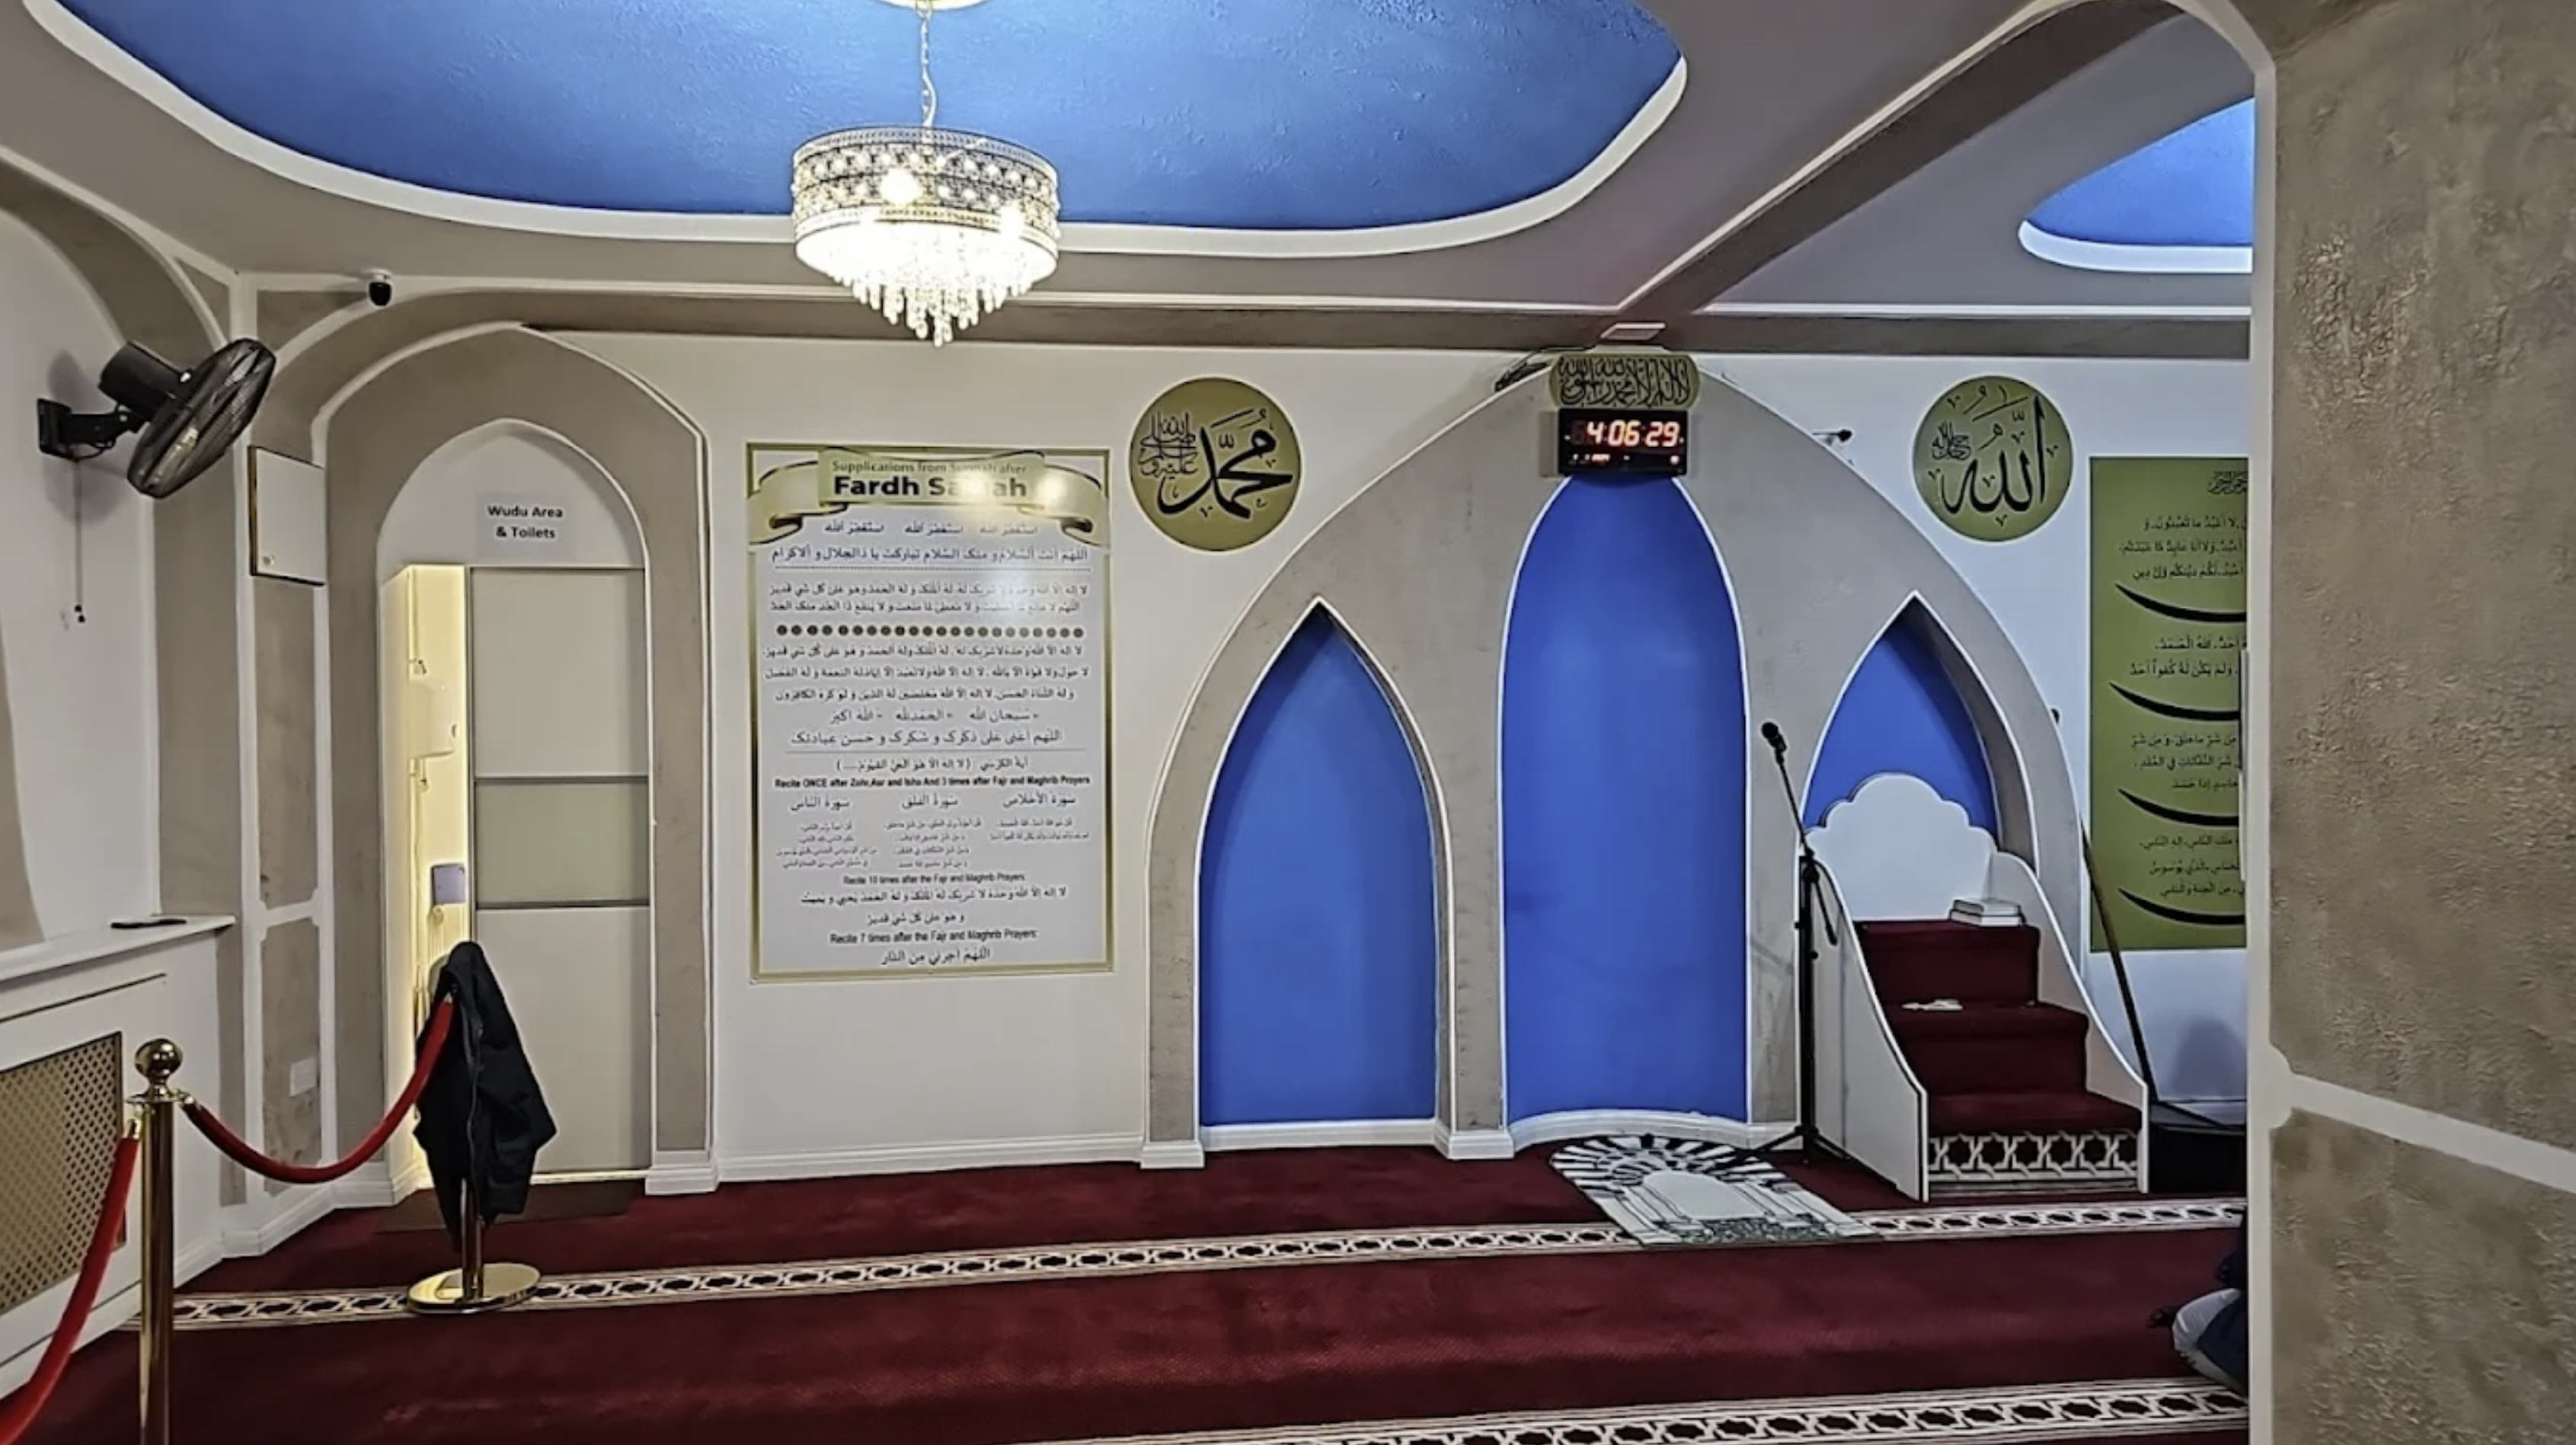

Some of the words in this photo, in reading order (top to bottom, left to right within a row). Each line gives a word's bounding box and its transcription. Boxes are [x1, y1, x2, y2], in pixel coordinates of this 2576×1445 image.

[1941, 395, 2046, 515] الله
[833, 460, 914, 474] Supplications
[917, 461, 947, 472] from
[999, 463, 1027, 474] after
[1157, 410, 1293, 520] محمد
[835, 476, 920, 496] Fardh
[487, 505, 528, 517] Wudu
[532, 507, 563, 517] Area
[496, 526, 507, 537] &
[510, 526, 556, 539] Toilets
[824, 519, 844, 532] الله
[905, 519, 924, 533] الله
[855, 705, 874, 721] الله
[970, 706, 986, 720] الله
[989, 708, 1031, 723] سبحان
[879, 735, 886, 746] و
[1033, 729, 1063, 745] اللهم
[775, 778, 801, 788] Recite
[803, 778, 827, 788] ONCE
[829, 778, 849, 788] after
[887, 777, 903, 787] and
[949, 777, 970, 785] times
[973, 776, 989, 785] after
[993, 775, 1007, 787] Fajr
[1010, 776, 1024, 785] and
[1028, 775, 1059, 787] Maghrib
[1060, 775, 1091, 787] Prayers
[843, 875, 867, 885] Recite
[869, 876, 878, 884] 10
[879, 875, 900, 884] times
[902, 875, 918, 884] after
[920, 874, 932, 884] the
[934, 874, 948, 884] Fajr
[950, 874, 964, 884] and
[966, 873, 995, 884] Maghrib
[829, 933, 858, 945] Recite
[860, 932, 866, 944] 7
[868, 932, 891, 943] times
[893, 931, 912, 942] after
[915, 931, 928, 941] the
[930, 929, 947, 942] Fajr
[949, 929, 965, 941] and
[968, 929, 1002, 942] Maghrib
[909, 953, 925, 966] من
